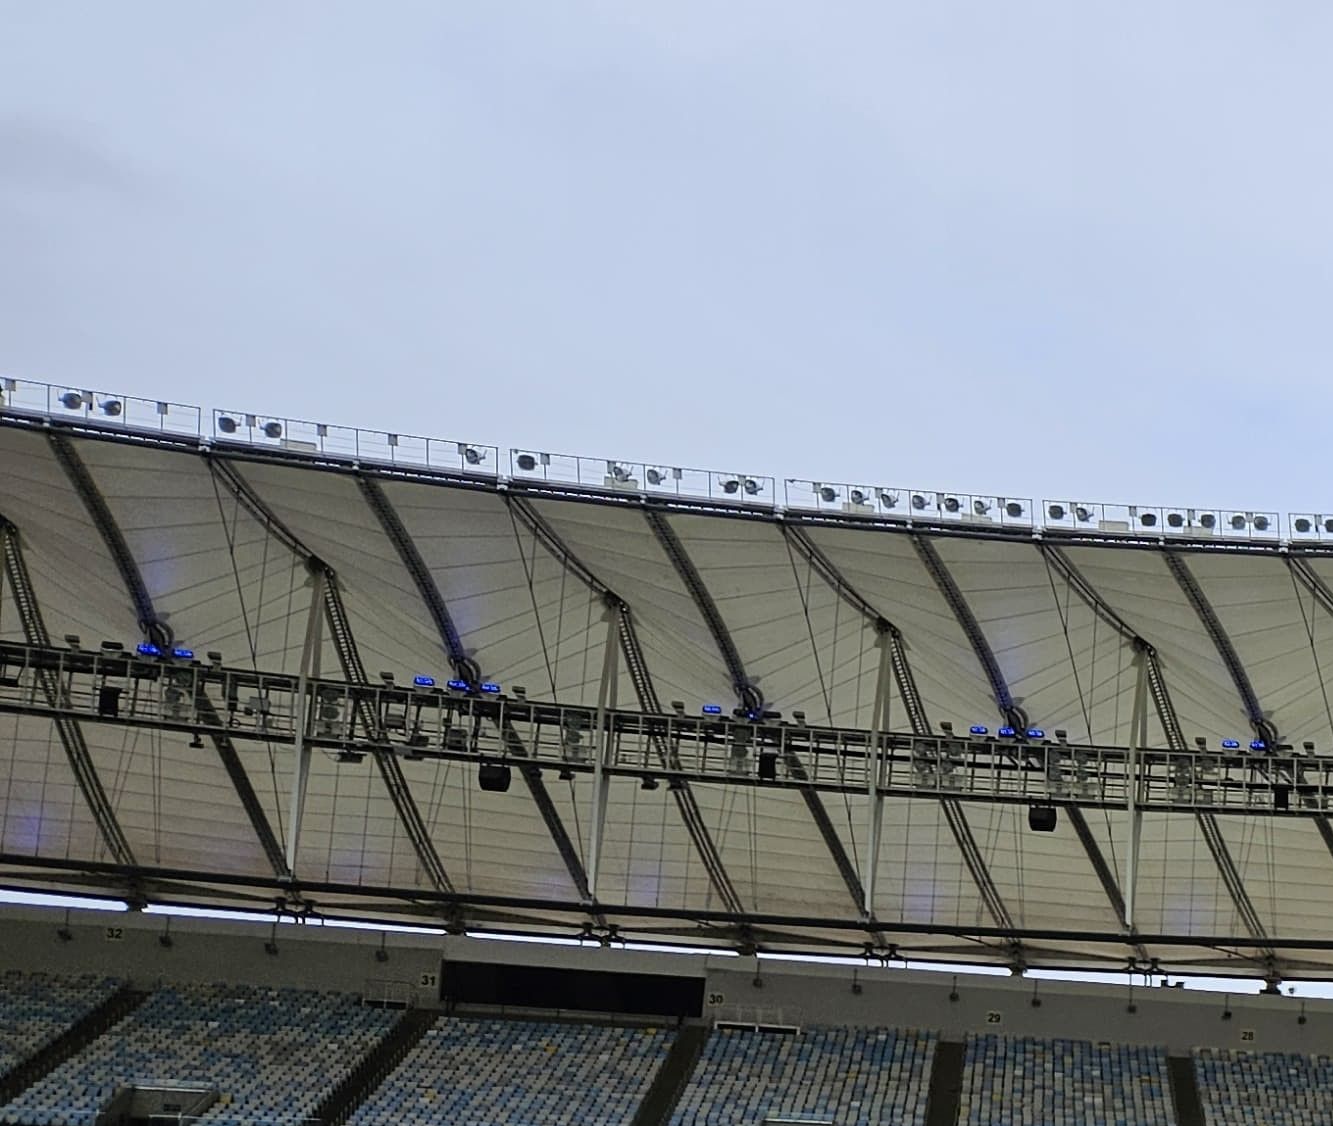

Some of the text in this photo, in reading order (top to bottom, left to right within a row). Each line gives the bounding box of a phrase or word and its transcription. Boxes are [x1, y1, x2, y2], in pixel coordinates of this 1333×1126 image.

[106, 927, 123, 940] 32
[421, 974, 436, 987] 31
[708, 993, 724, 1005] 30
[987, 1012, 1001, 1024] 29
[1241, 1031, 1255, 1042] 28
